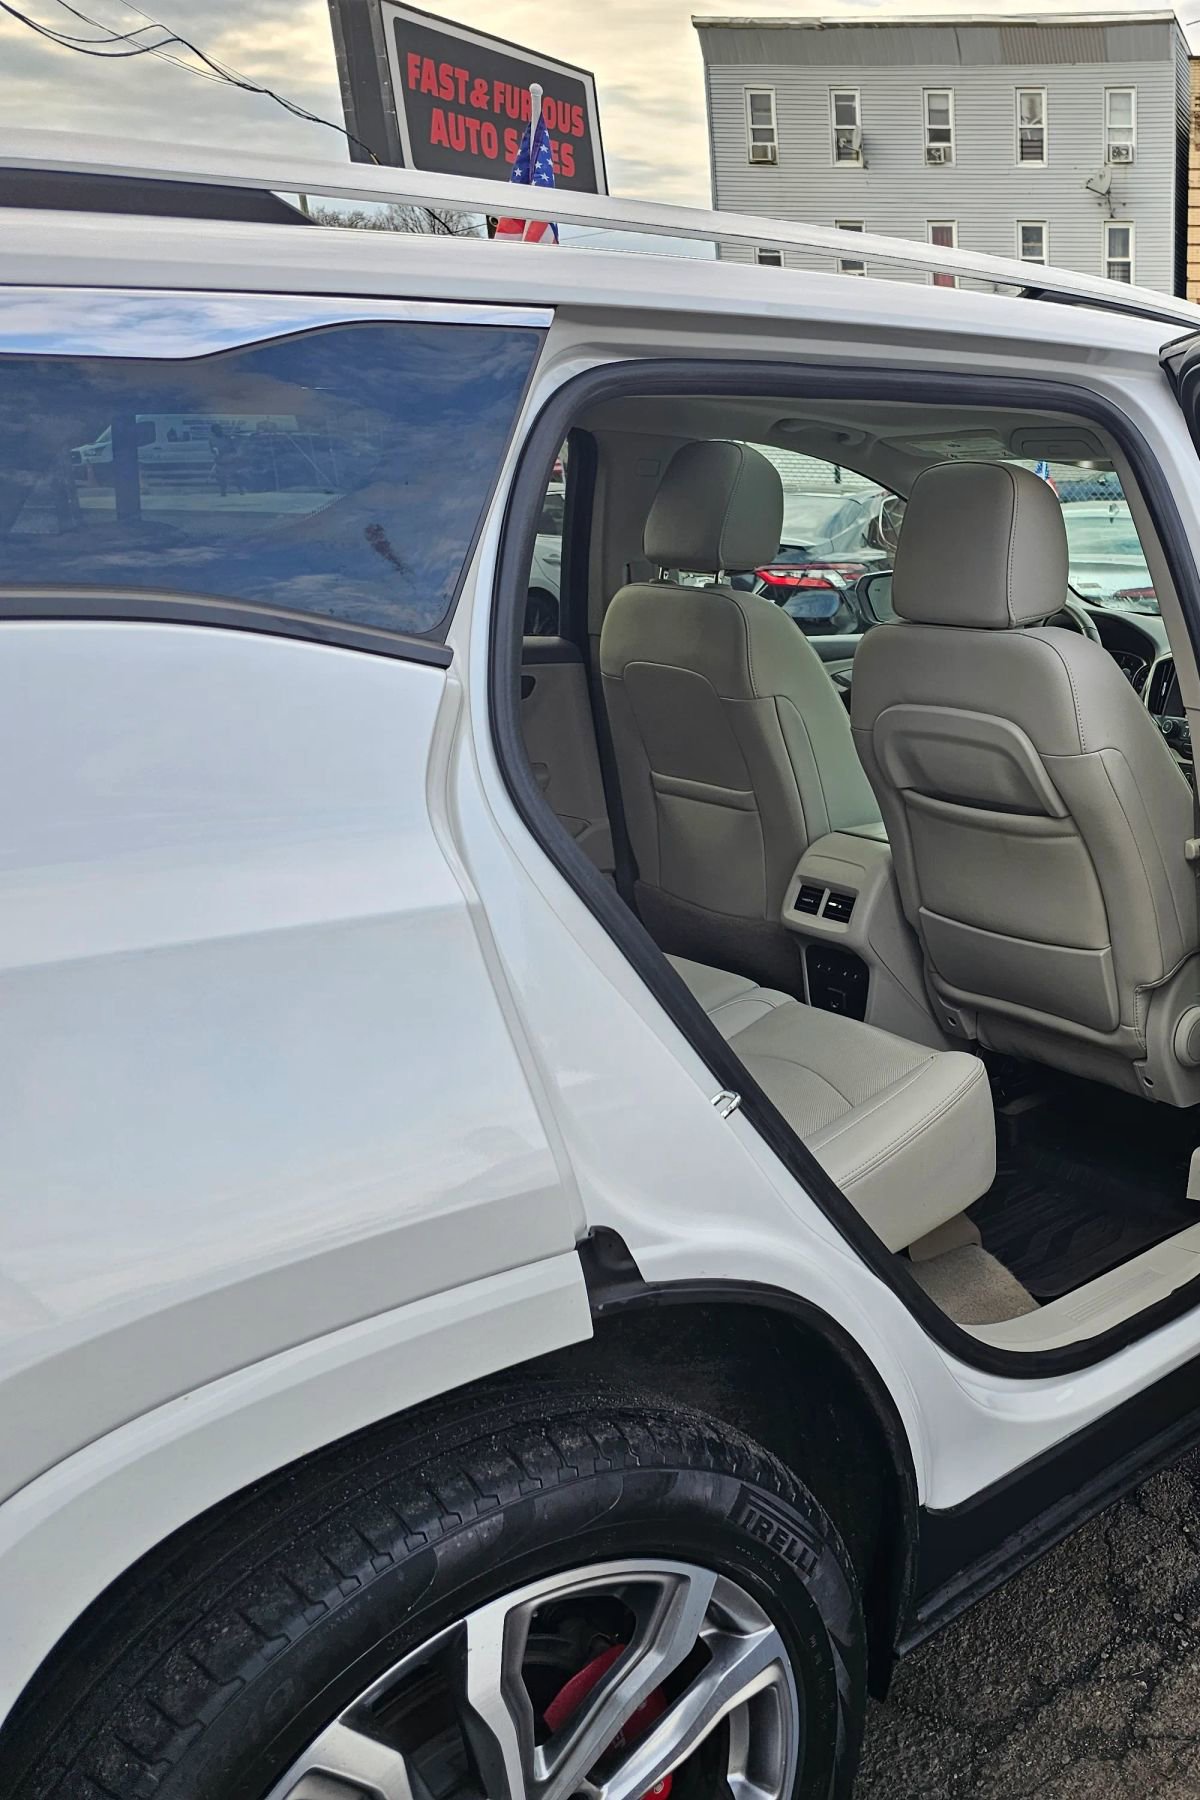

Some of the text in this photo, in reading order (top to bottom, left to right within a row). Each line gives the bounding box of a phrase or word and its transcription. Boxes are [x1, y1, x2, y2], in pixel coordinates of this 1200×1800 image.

[407, 52, 585, 138] FAST & FUROUS
[430, 108, 576, 178] AUTO SES
[726, 1483, 821, 1578] PIRELLI
